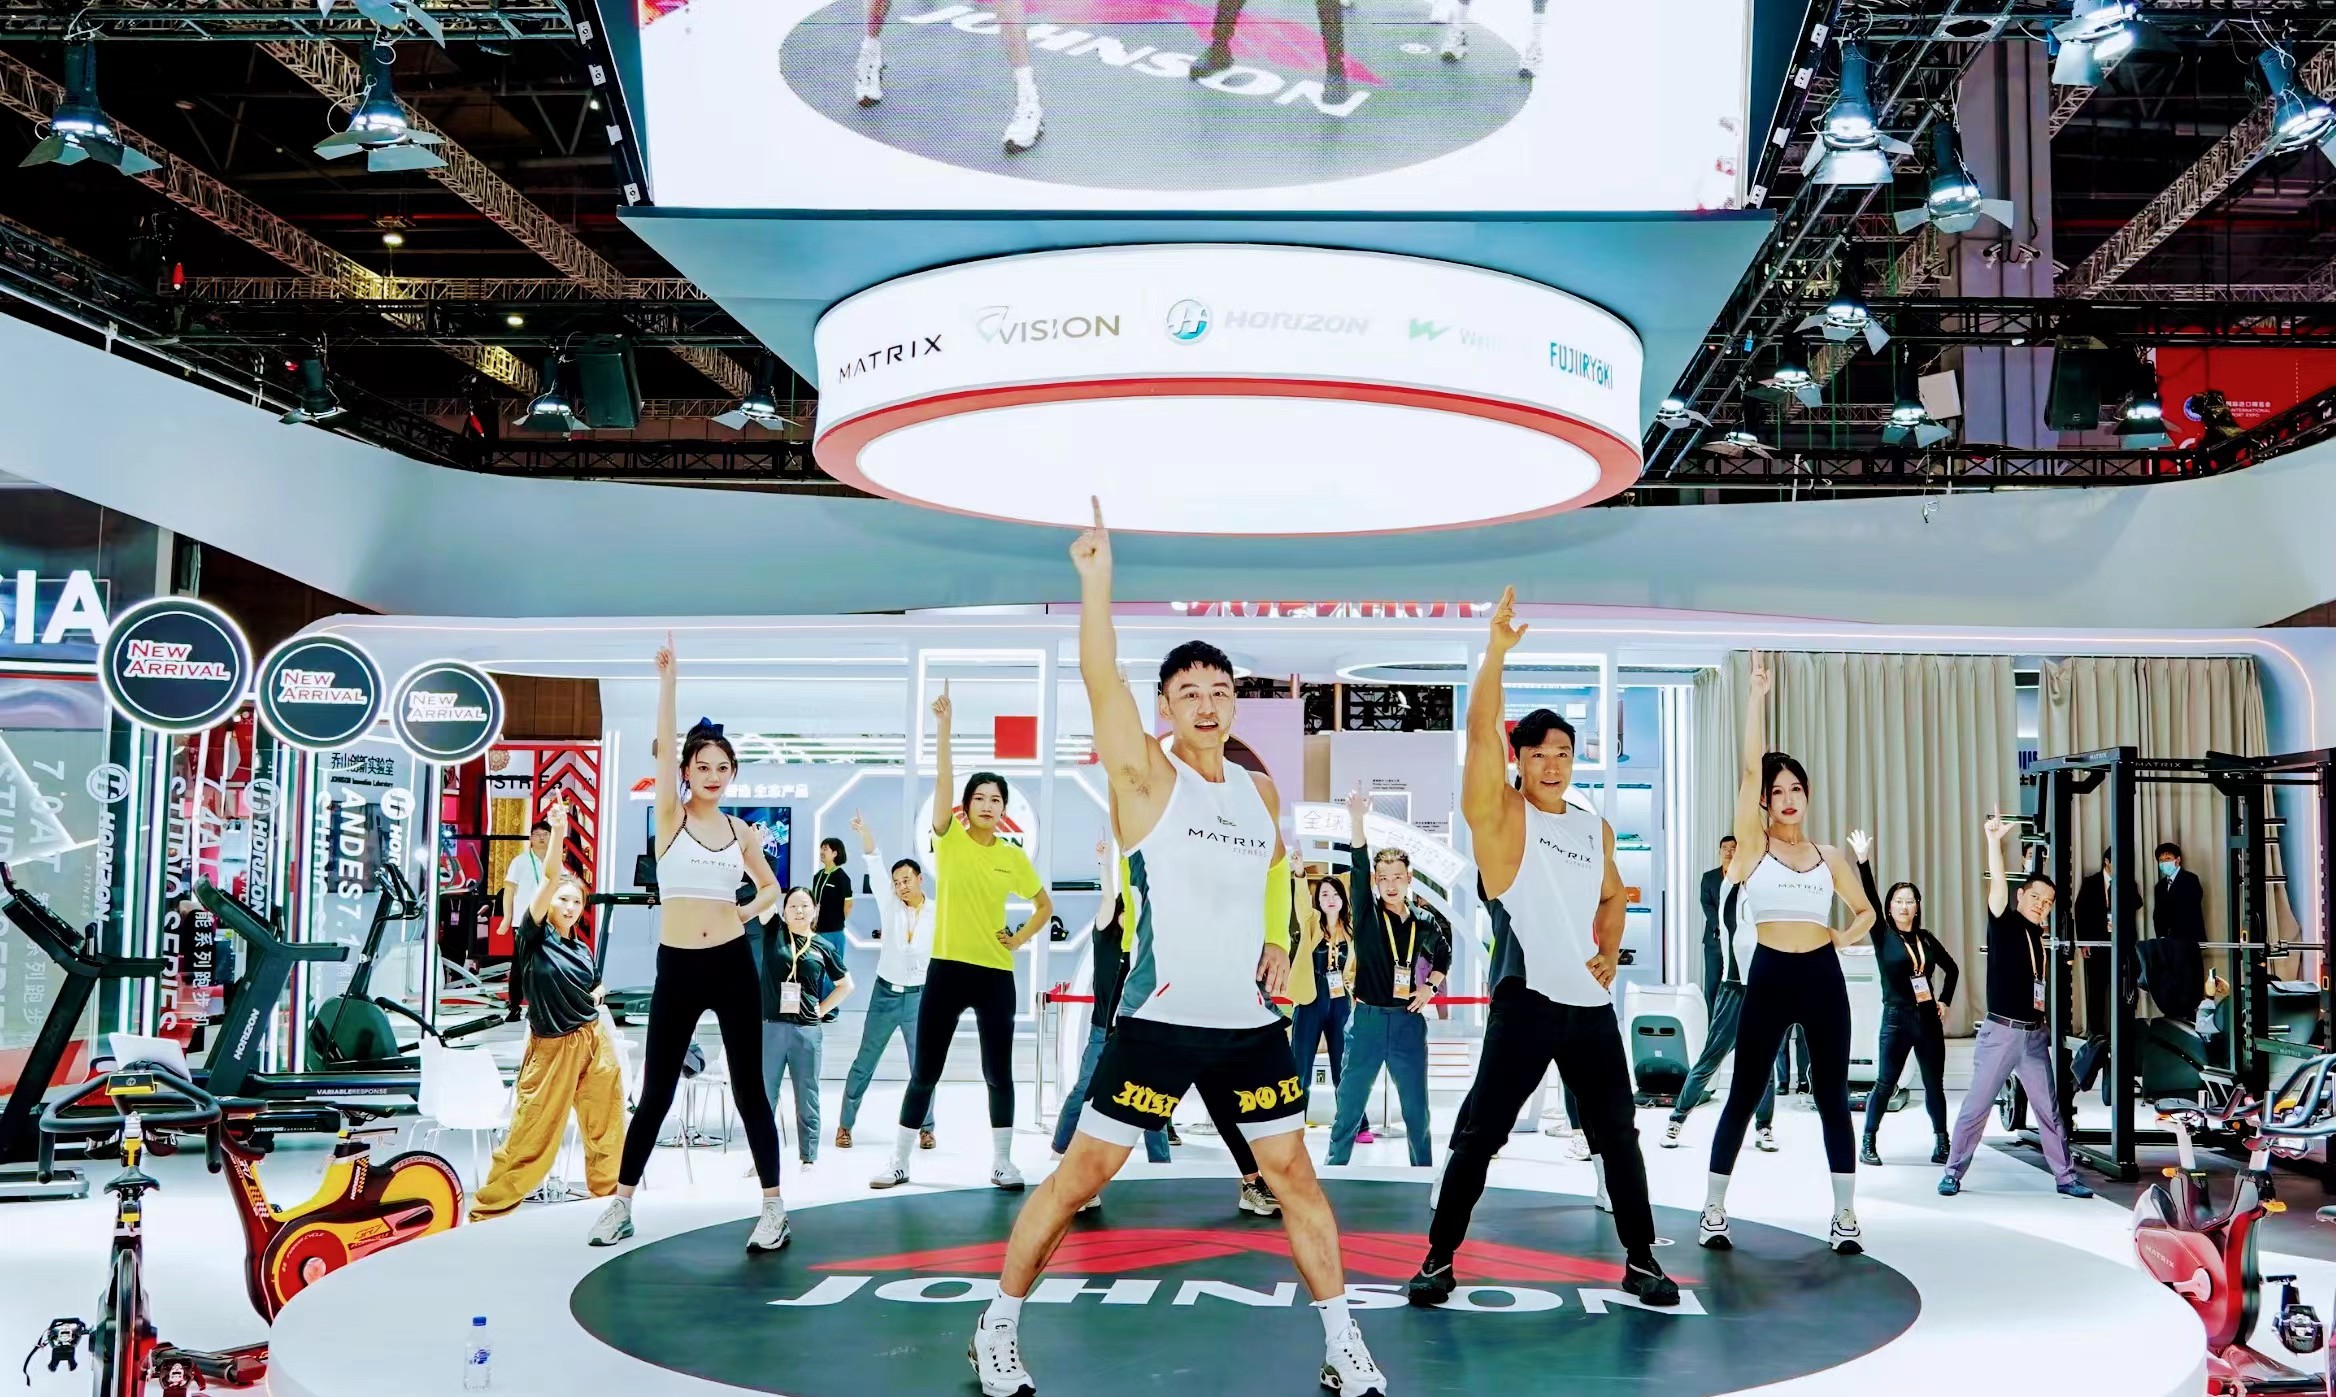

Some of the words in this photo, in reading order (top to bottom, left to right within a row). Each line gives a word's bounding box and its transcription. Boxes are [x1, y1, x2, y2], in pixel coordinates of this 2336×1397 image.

[999, 315, 1120, 345] VISION
[1225, 310, 1369, 335] HORIZON
[839, 334, 943, 384] MATRIX
[0, 570, 110, 644] IA
[130, 641, 190, 660] NEW
[127, 660, 230, 679] ARRIVAL
[283, 672, 333, 687] NEW
[281, 687, 366, 703] ARRIVAL
[411, 692, 455, 706] NEW
[409, 706, 486, 720] ARRIVAL
[1188, 828, 1266, 849] MATRIX
[1539, 837, 1592, 863] MATRIX
[95, 811, 116, 923] HORIZON
[690, 858, 738, 868] MATRIX
[1778, 883, 1824, 892] MATRIX
[233, 1008, 260, 1061] HORIZON
[2145, 1244, 2175, 1269] MATRIX
[767, 1275, 1709, 1316] JOHNSON
